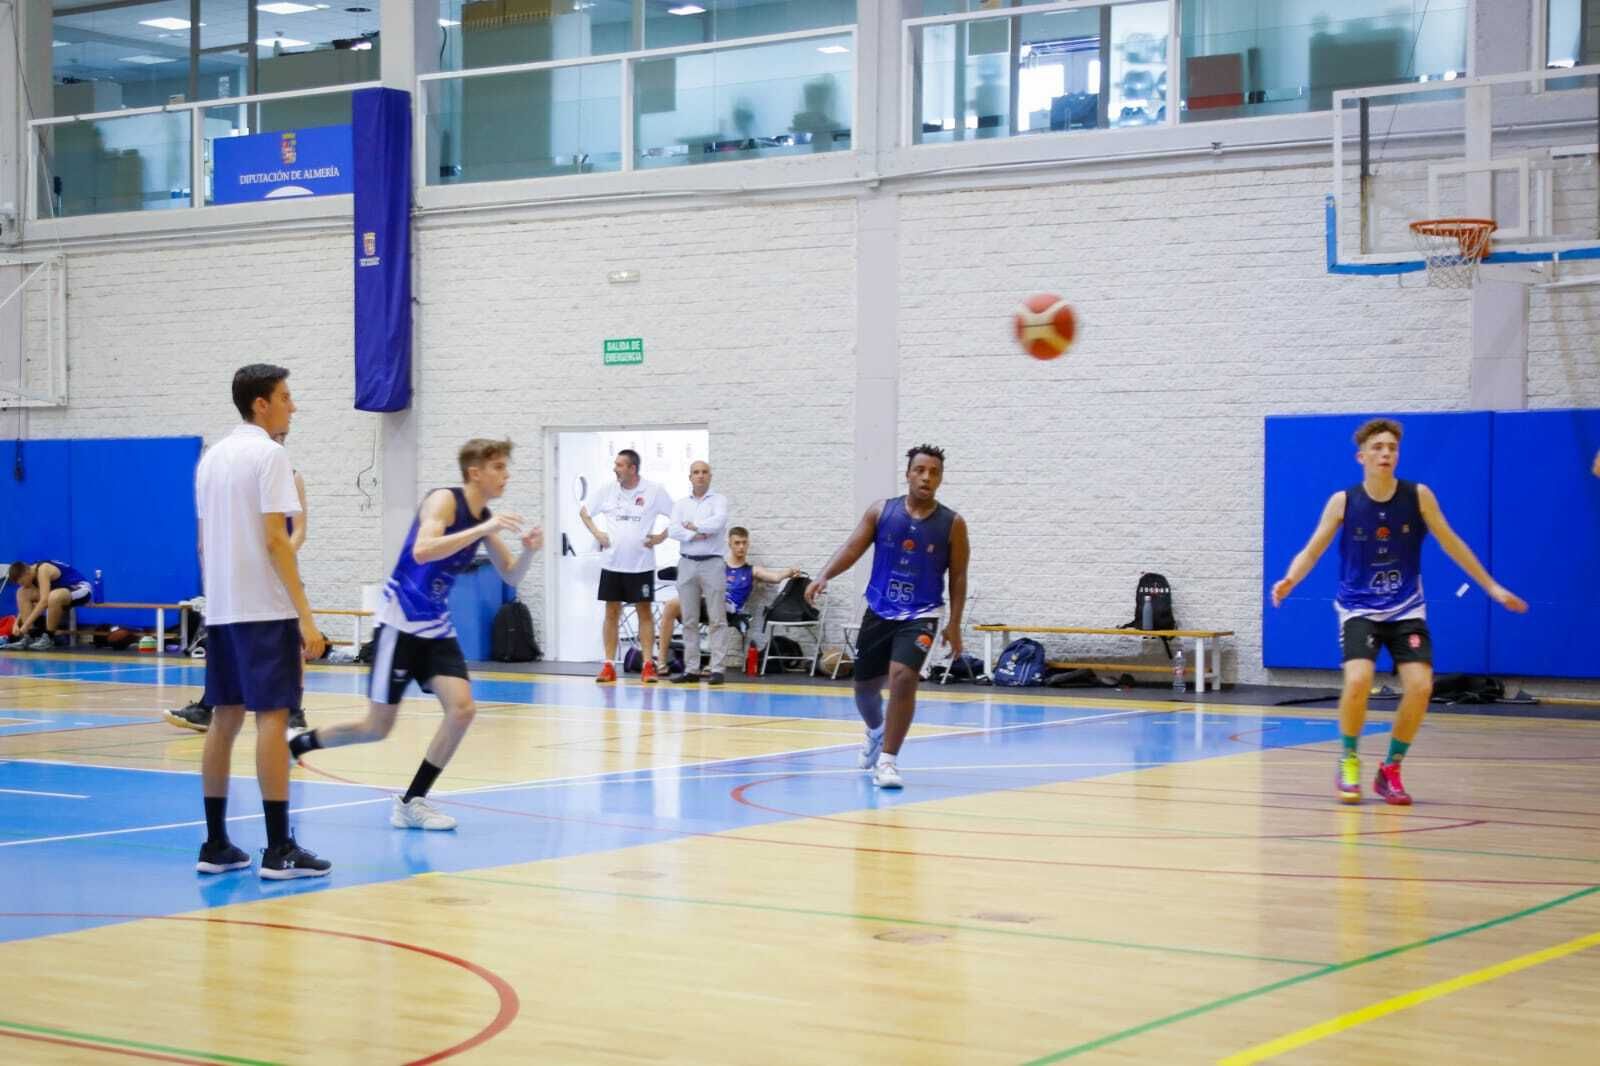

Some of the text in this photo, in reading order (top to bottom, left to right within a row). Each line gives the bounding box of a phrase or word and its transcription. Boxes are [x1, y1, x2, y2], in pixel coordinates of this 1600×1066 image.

[239, 165, 340, 185] DIPUTACIÓN DE ALMERÍA
[606, 340, 641, 352] SALIDA DE
[605, 351, 642, 362] EMERGENCIA
[886, 578, 915, 605] 65
